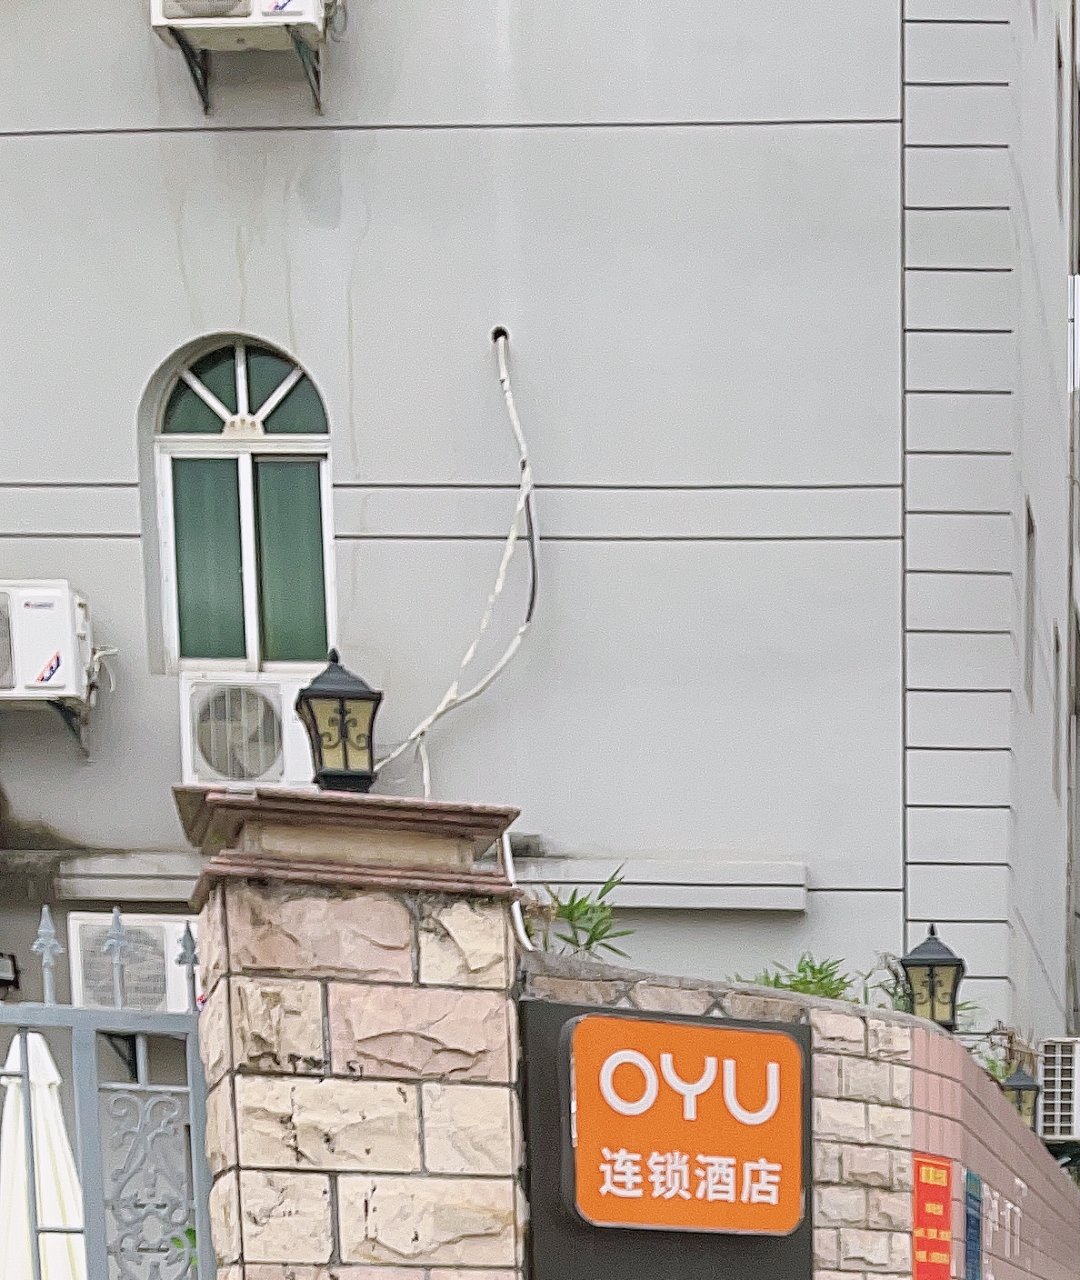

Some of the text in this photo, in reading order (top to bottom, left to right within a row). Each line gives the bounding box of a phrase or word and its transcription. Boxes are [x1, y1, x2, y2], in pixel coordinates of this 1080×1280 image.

[599, 1048, 781, 1125] OYU
[598, 1147, 782, 1205] 连锁酒店
